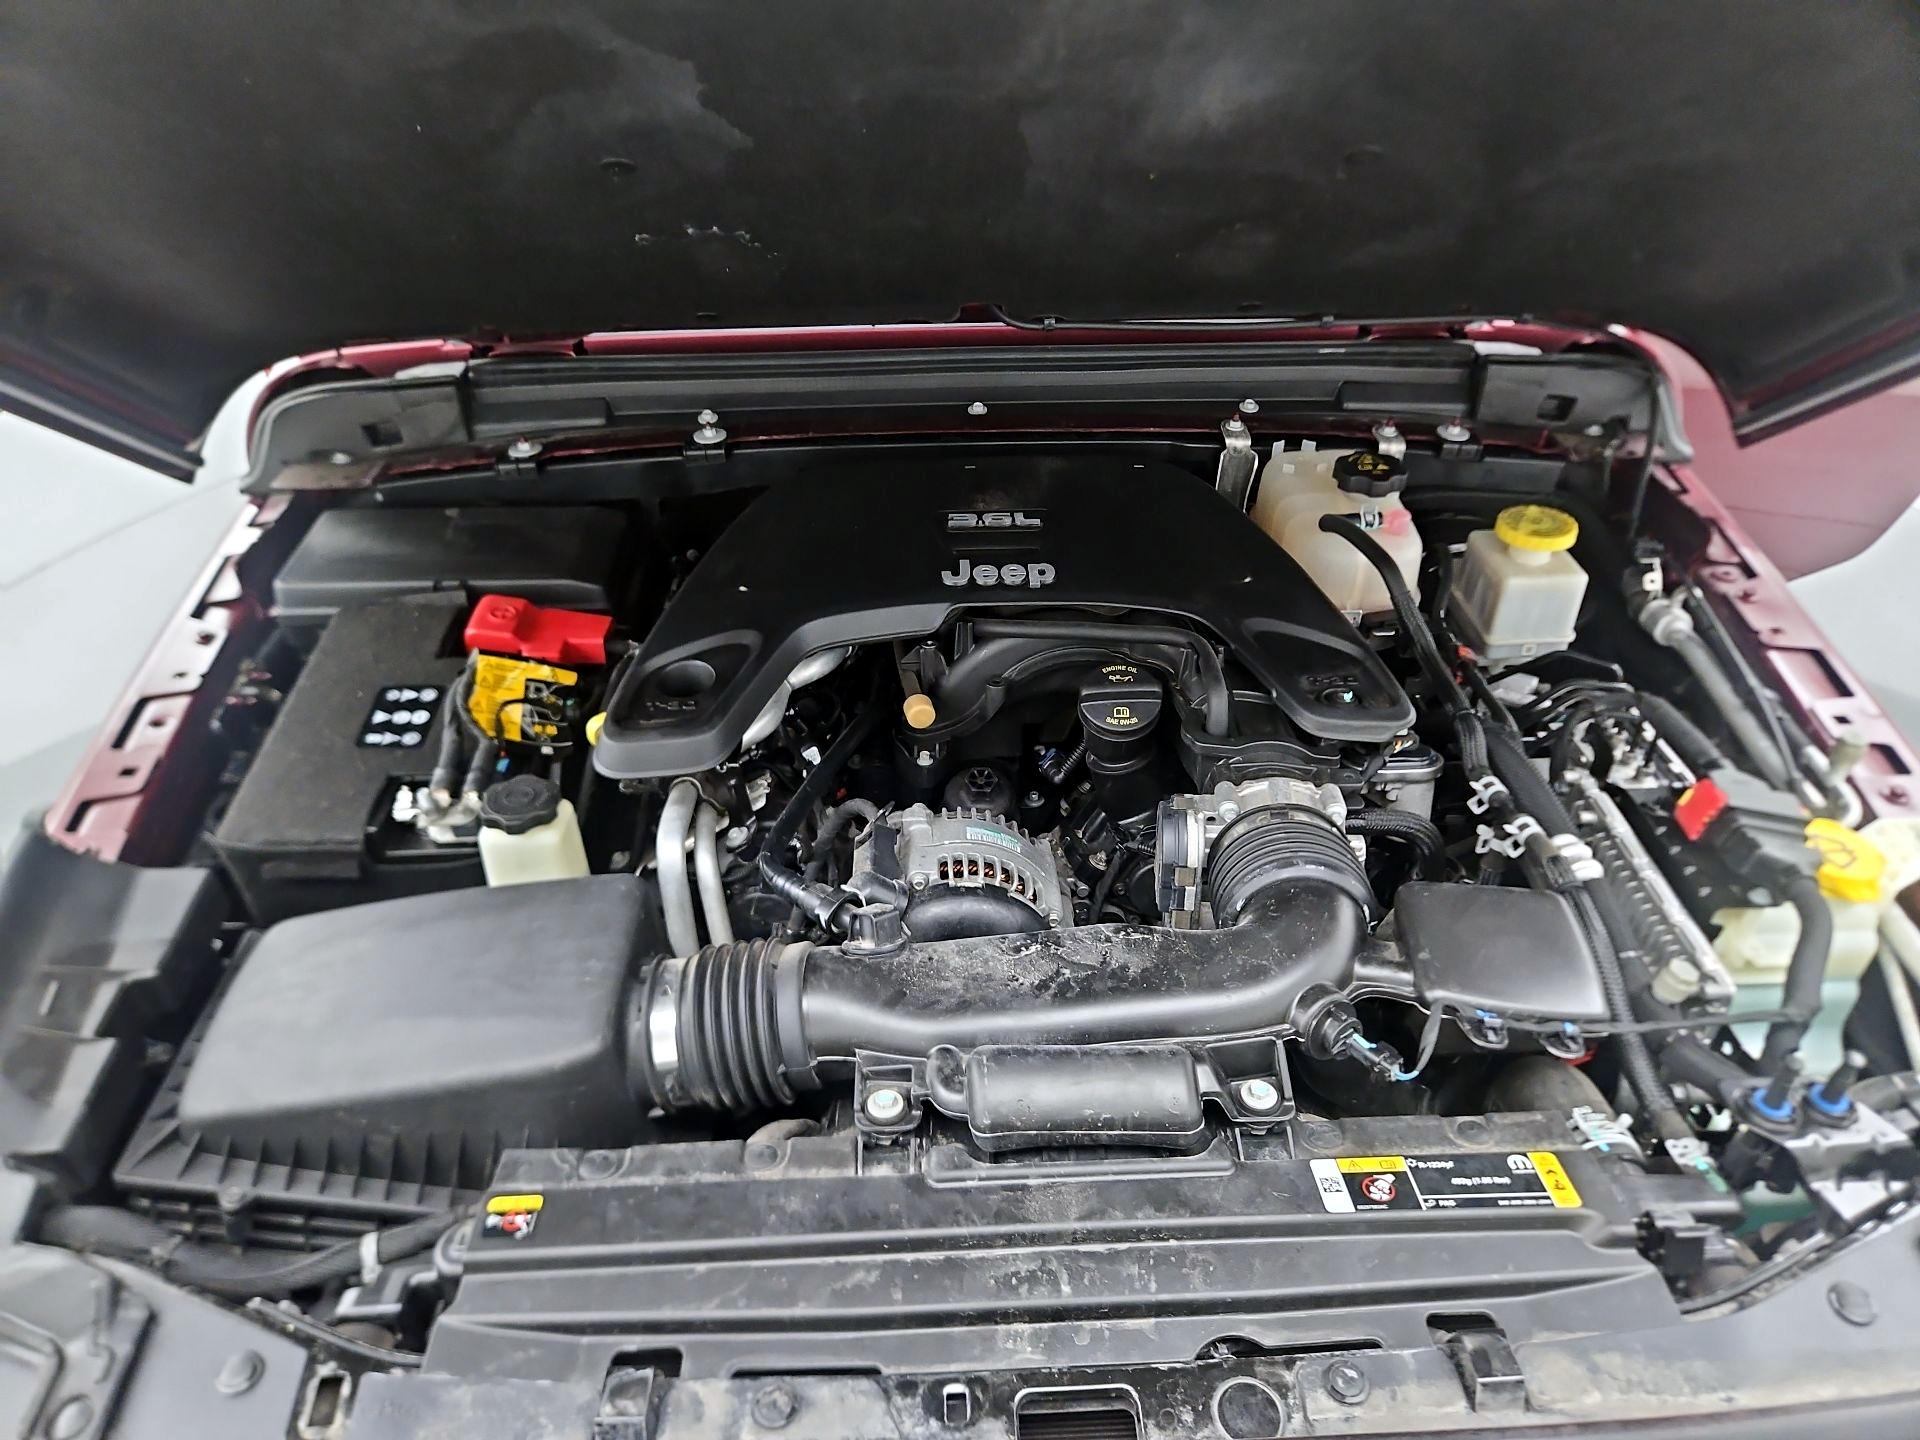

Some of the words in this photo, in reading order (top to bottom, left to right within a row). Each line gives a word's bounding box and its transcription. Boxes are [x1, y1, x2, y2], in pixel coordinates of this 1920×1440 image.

[948, 512, 1041, 527] 3.6L
[941, 559, 1056, 588] Jeep
[1102, 665, 1126, 673] ENGINE
